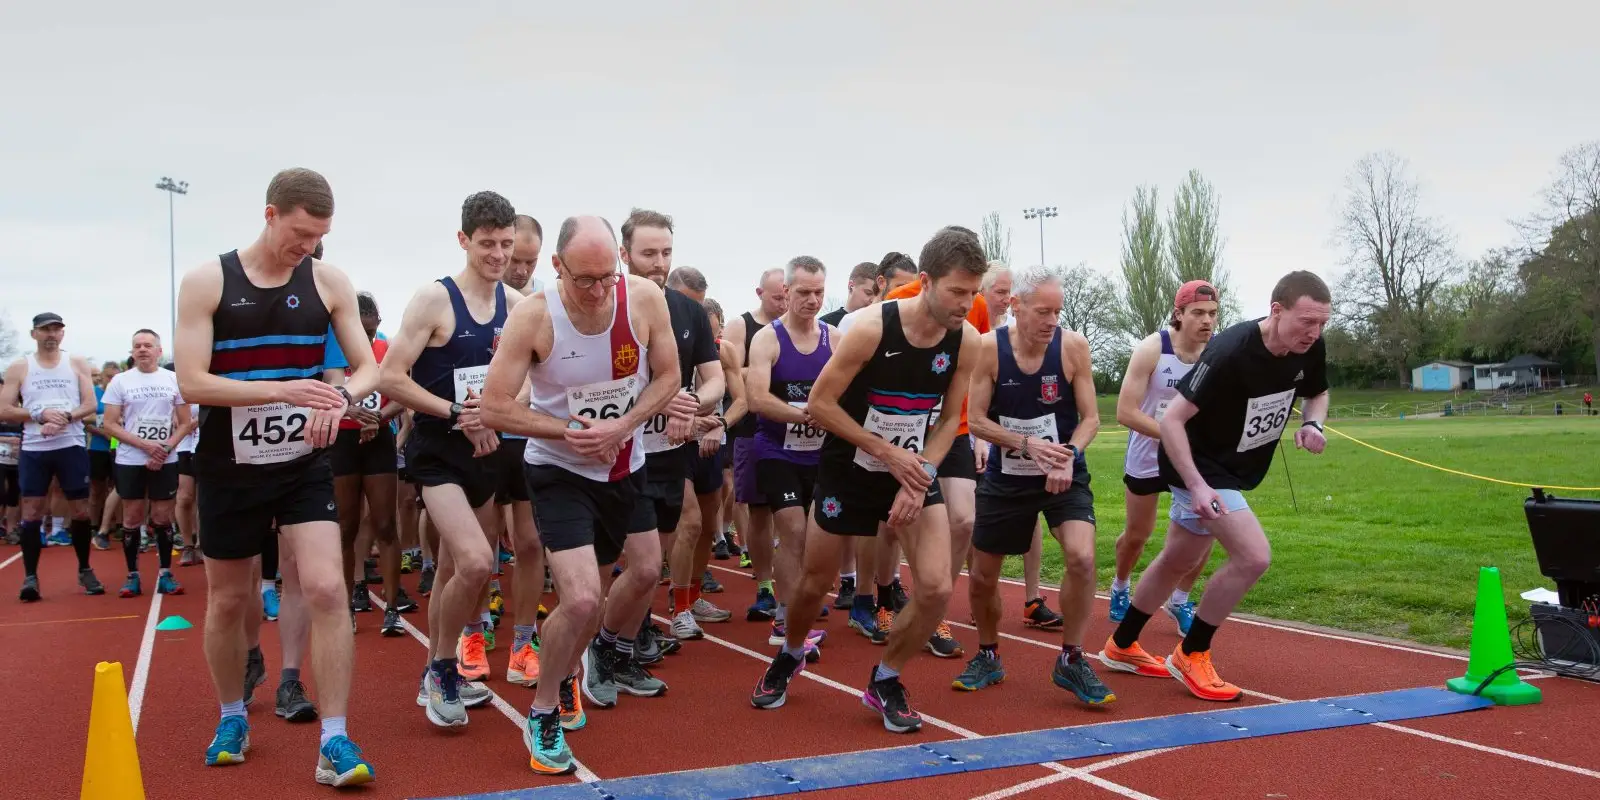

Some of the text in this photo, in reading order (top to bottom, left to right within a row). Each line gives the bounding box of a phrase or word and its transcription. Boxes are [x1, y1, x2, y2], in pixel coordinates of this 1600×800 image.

[602, 386, 626, 395] PEPPER
[585, 395, 619, 403] MEMORIAL
[247, 405, 283, 413] MEMORIAL
[1246, 407, 1286, 438] 336
[137, 426, 168, 441] 526
[238, 413, 308, 446] 452
[877, 425, 906, 433] MEMORIAL
